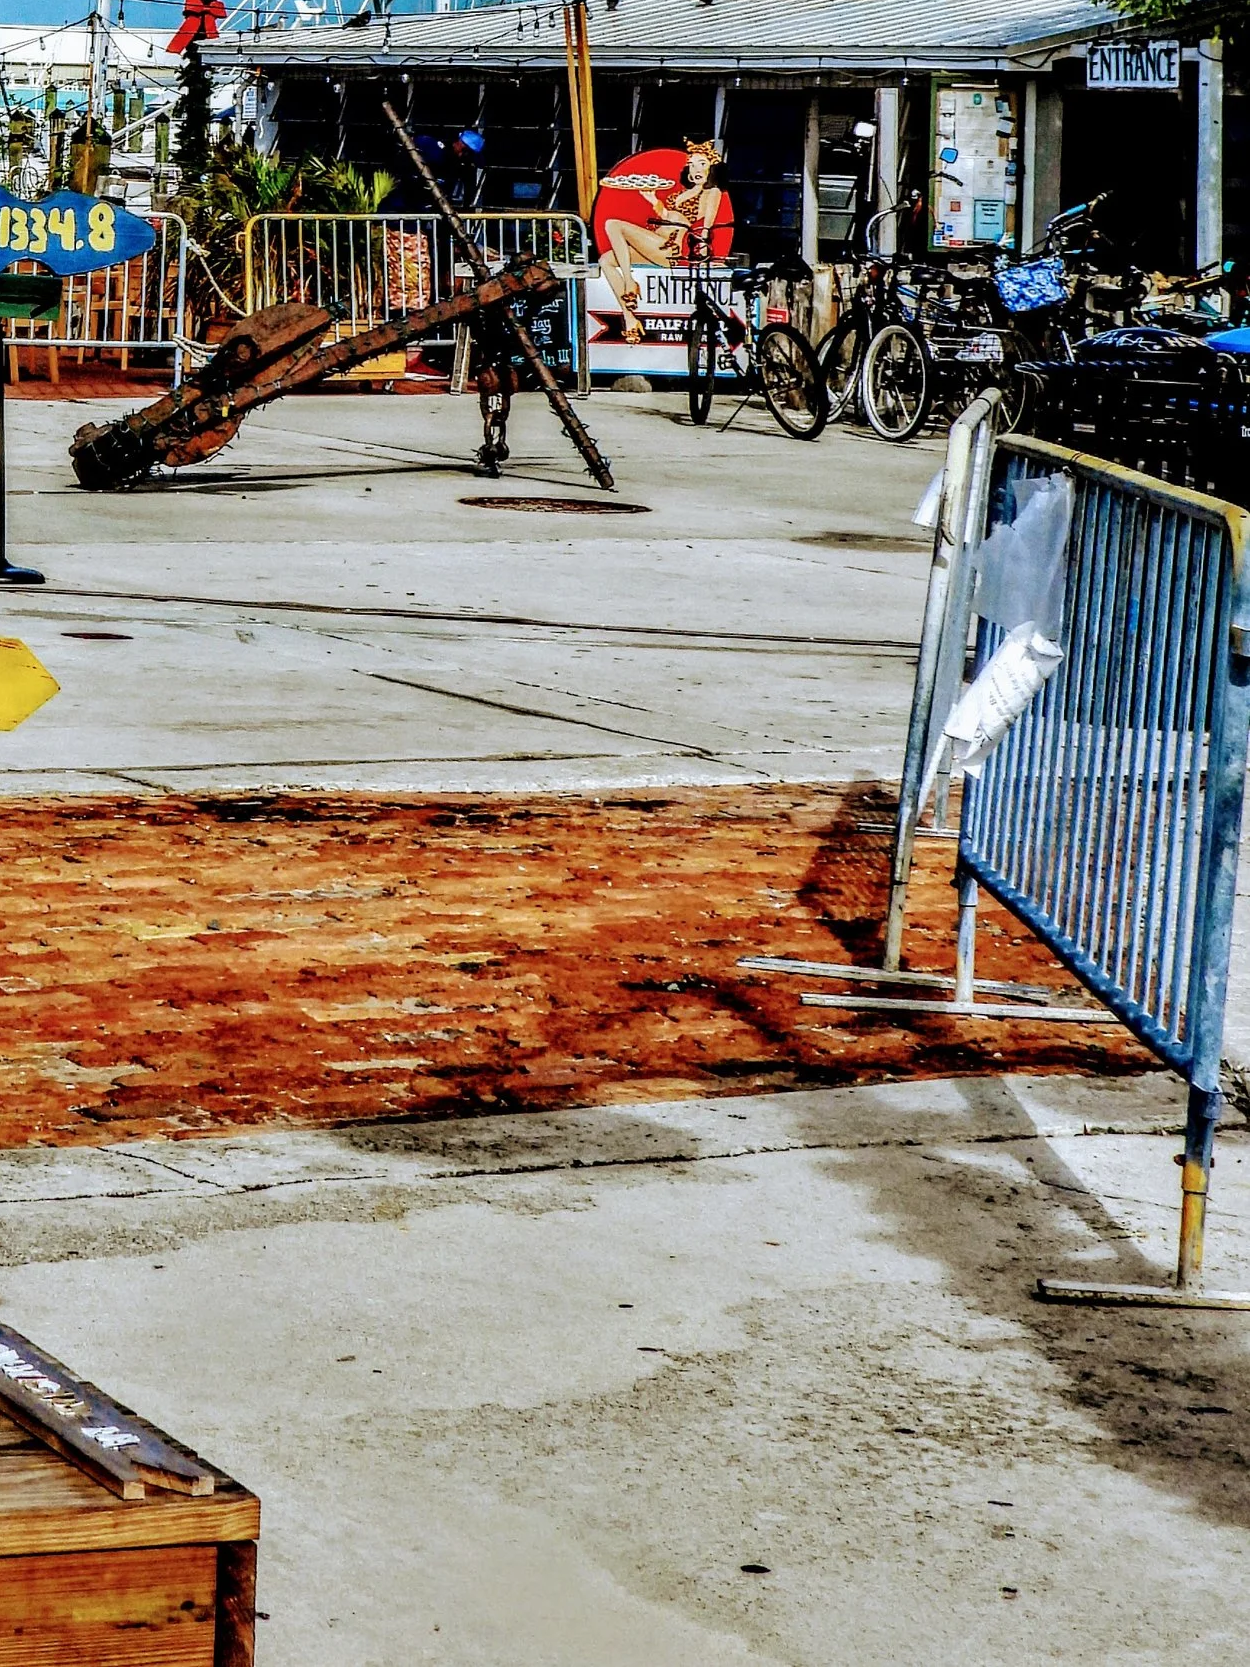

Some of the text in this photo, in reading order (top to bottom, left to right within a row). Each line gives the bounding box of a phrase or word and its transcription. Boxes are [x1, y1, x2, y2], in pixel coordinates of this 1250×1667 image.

[1088, 46, 1178, 82] ENTRANCE
[644, 318, 684, 331] HALF
[660, 333, 683, 341] RAW
